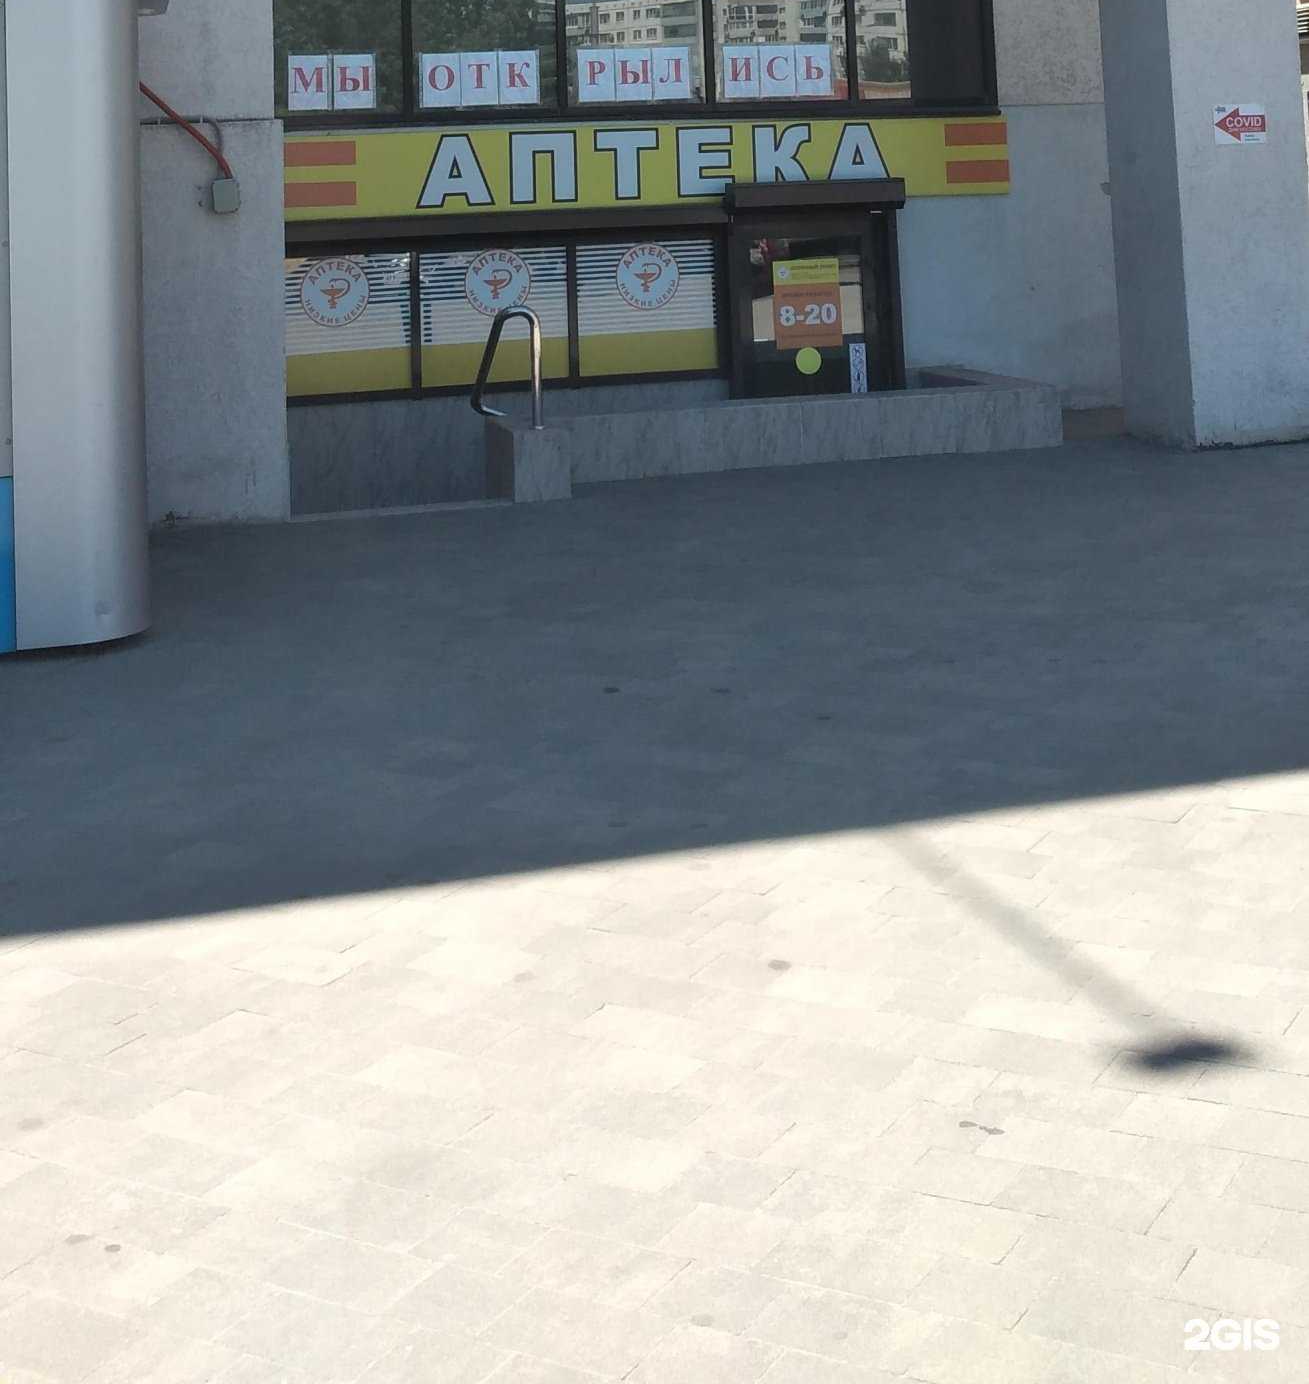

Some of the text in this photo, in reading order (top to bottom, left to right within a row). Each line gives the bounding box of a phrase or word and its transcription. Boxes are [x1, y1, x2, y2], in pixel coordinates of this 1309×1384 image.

[293, 66, 370, 94] МЫ
[1226, 117, 1262, 127] COVID
[416, 122, 890, 209] АПТЕКА
[472, 252, 523, 276] АПТЕКА
[623, 246, 673, 269] АПТЕКА
[308, 261, 361, 285] АПТЕКА
[779, 303, 838, 327] 8-20
